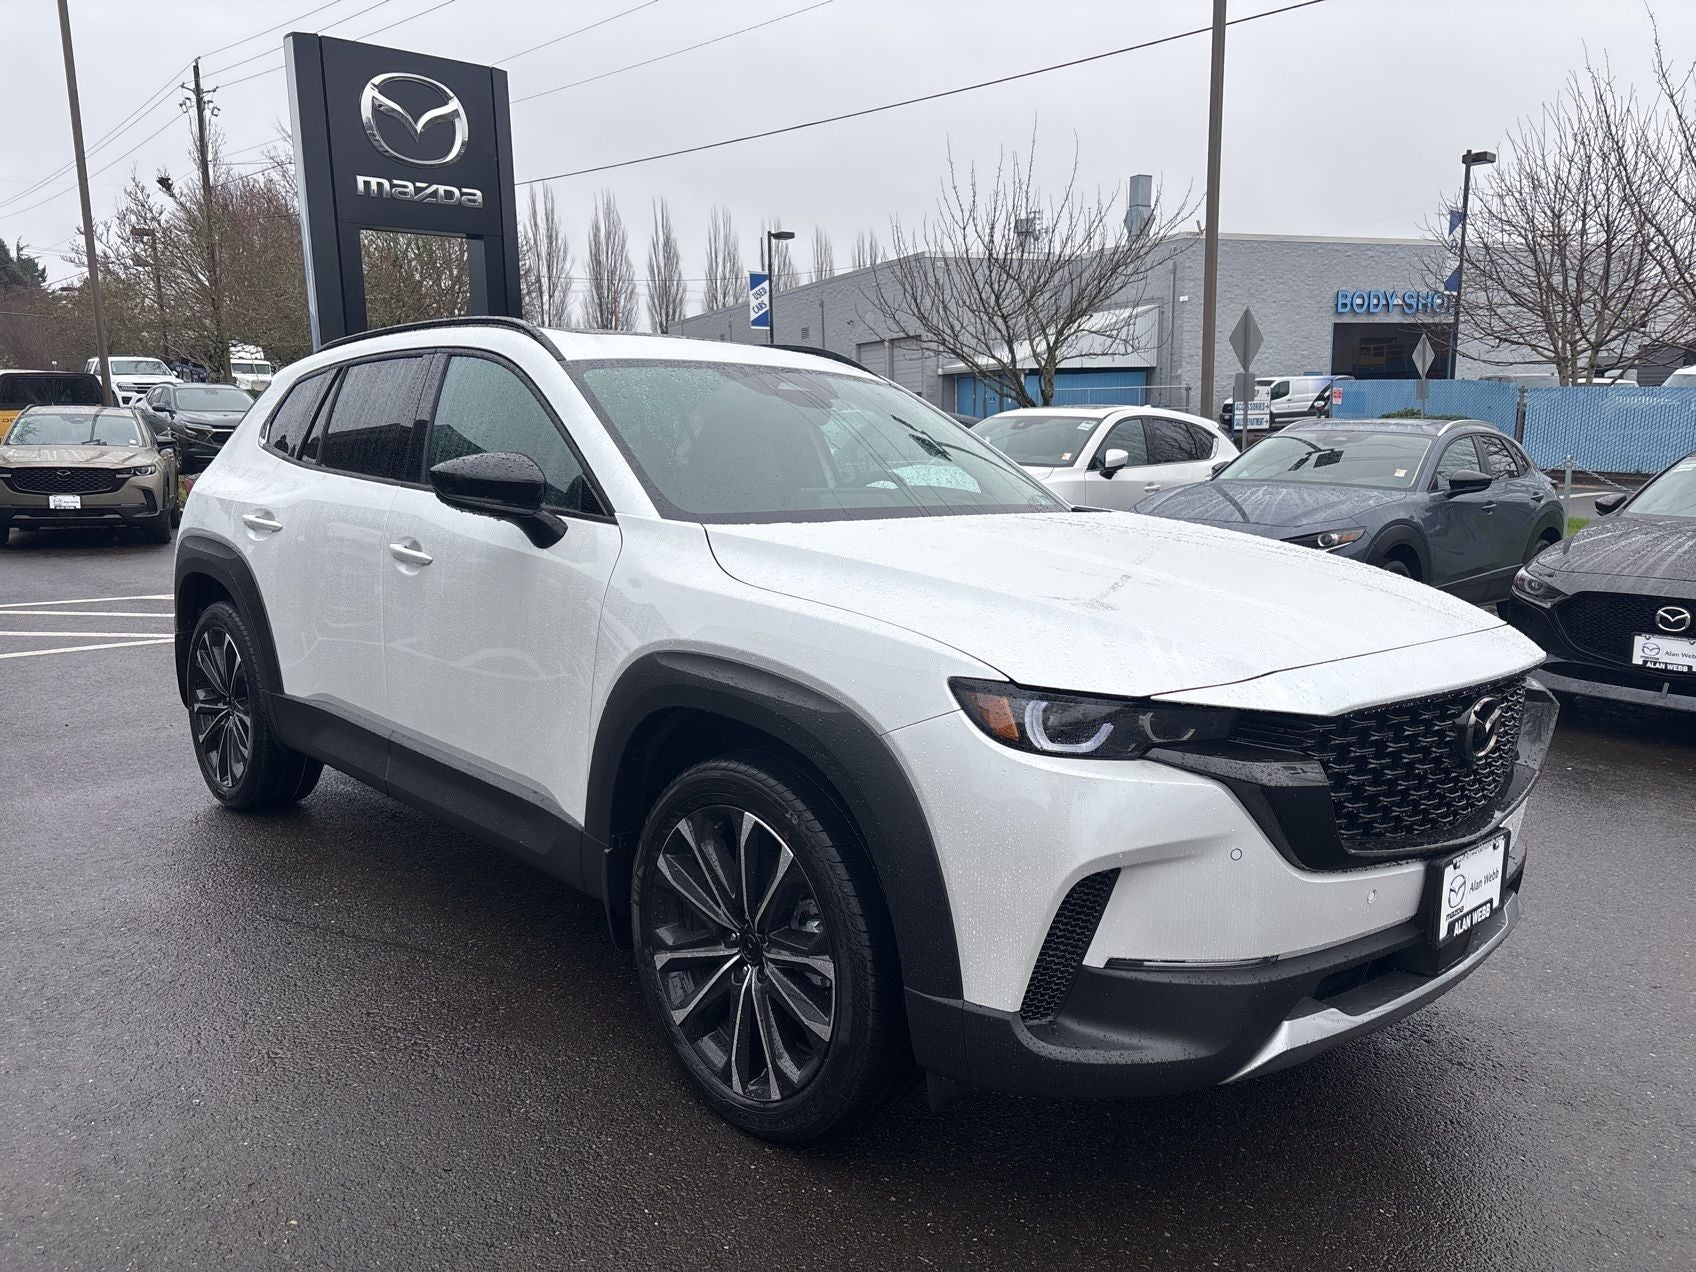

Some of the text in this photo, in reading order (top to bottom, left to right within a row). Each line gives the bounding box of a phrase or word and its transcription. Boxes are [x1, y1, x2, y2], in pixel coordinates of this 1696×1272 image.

[355, 175, 484, 209] mazda
[751, 286, 768, 300] USED
[1336, 288, 1397, 314] BODY
[752, 300, 768, 314] CARS
[1646, 661, 1688, 672] ALAN WEBB
[1469, 870, 1500, 894] Alan Webb
[1454, 903, 1491, 937] ALAN WEBB
